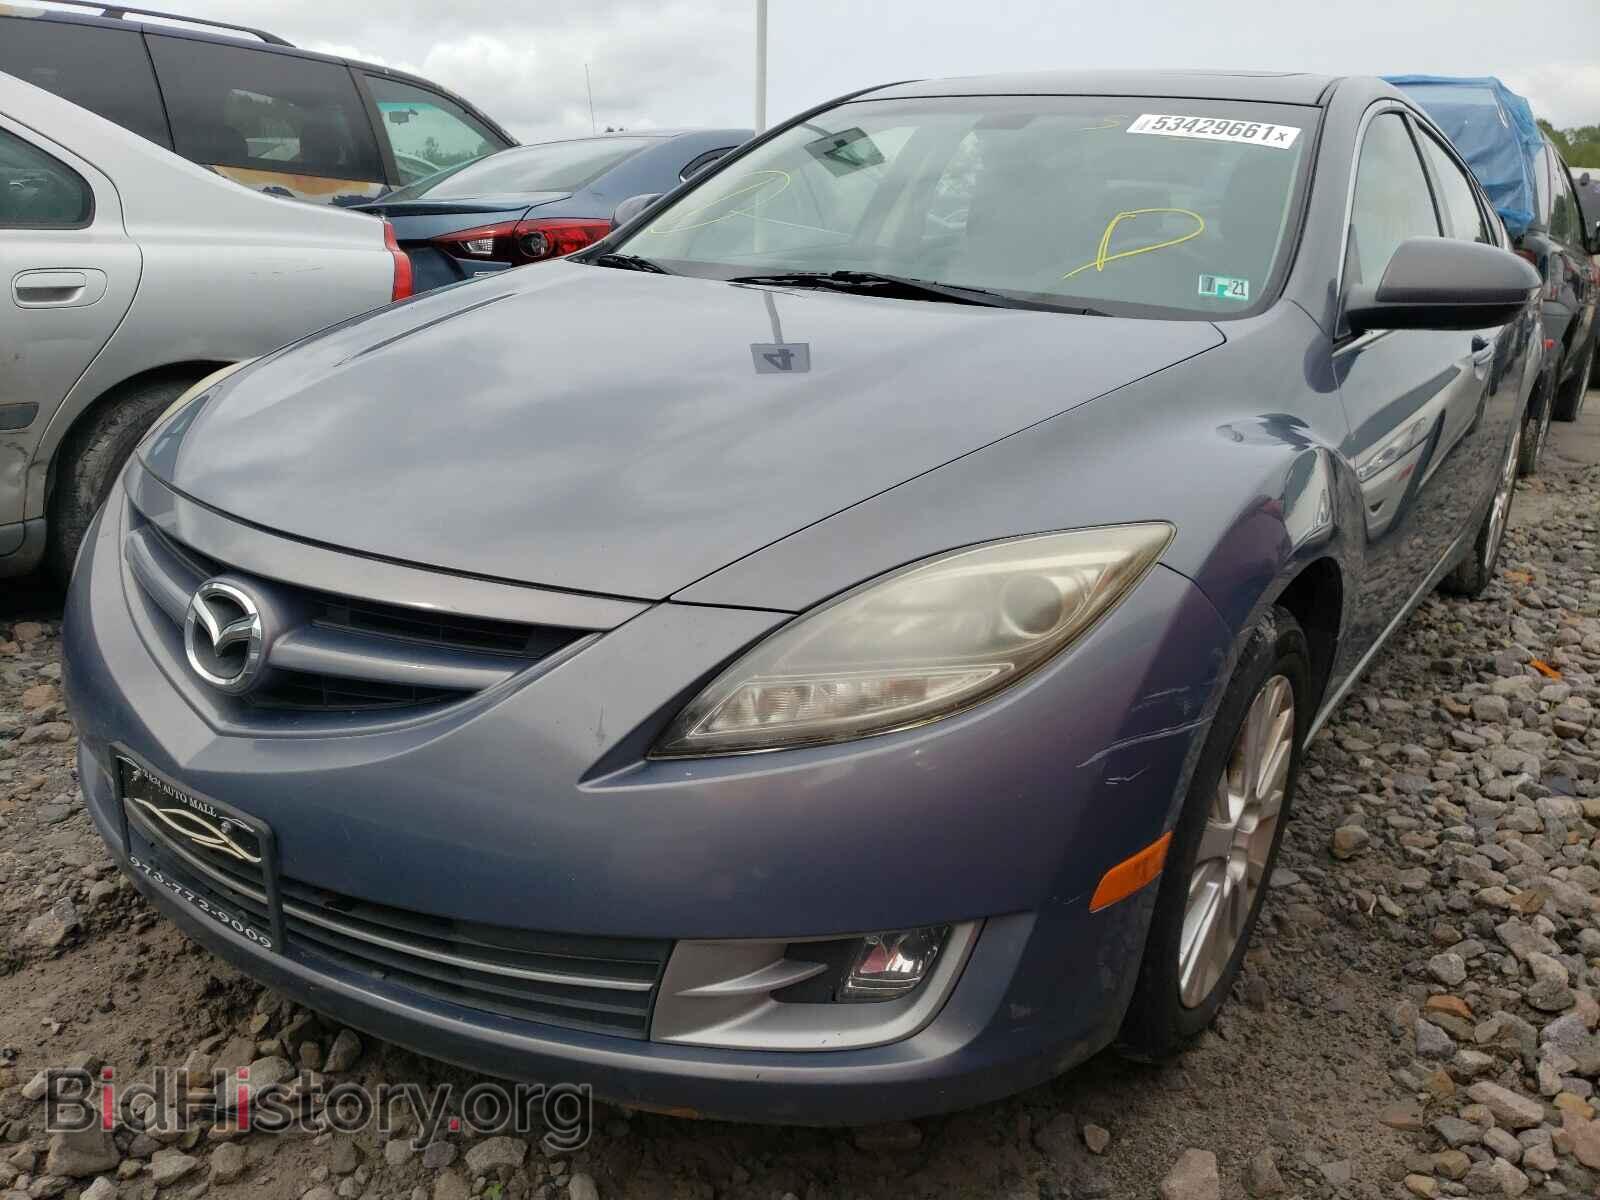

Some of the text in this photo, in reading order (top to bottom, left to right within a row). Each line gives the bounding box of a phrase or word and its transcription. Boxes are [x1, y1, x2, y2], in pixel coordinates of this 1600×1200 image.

[1151, 116, 1275, 141] 53429661
[1231, 280, 1246, 296] 21
[163, 784, 217, 817] AUTO MALL
